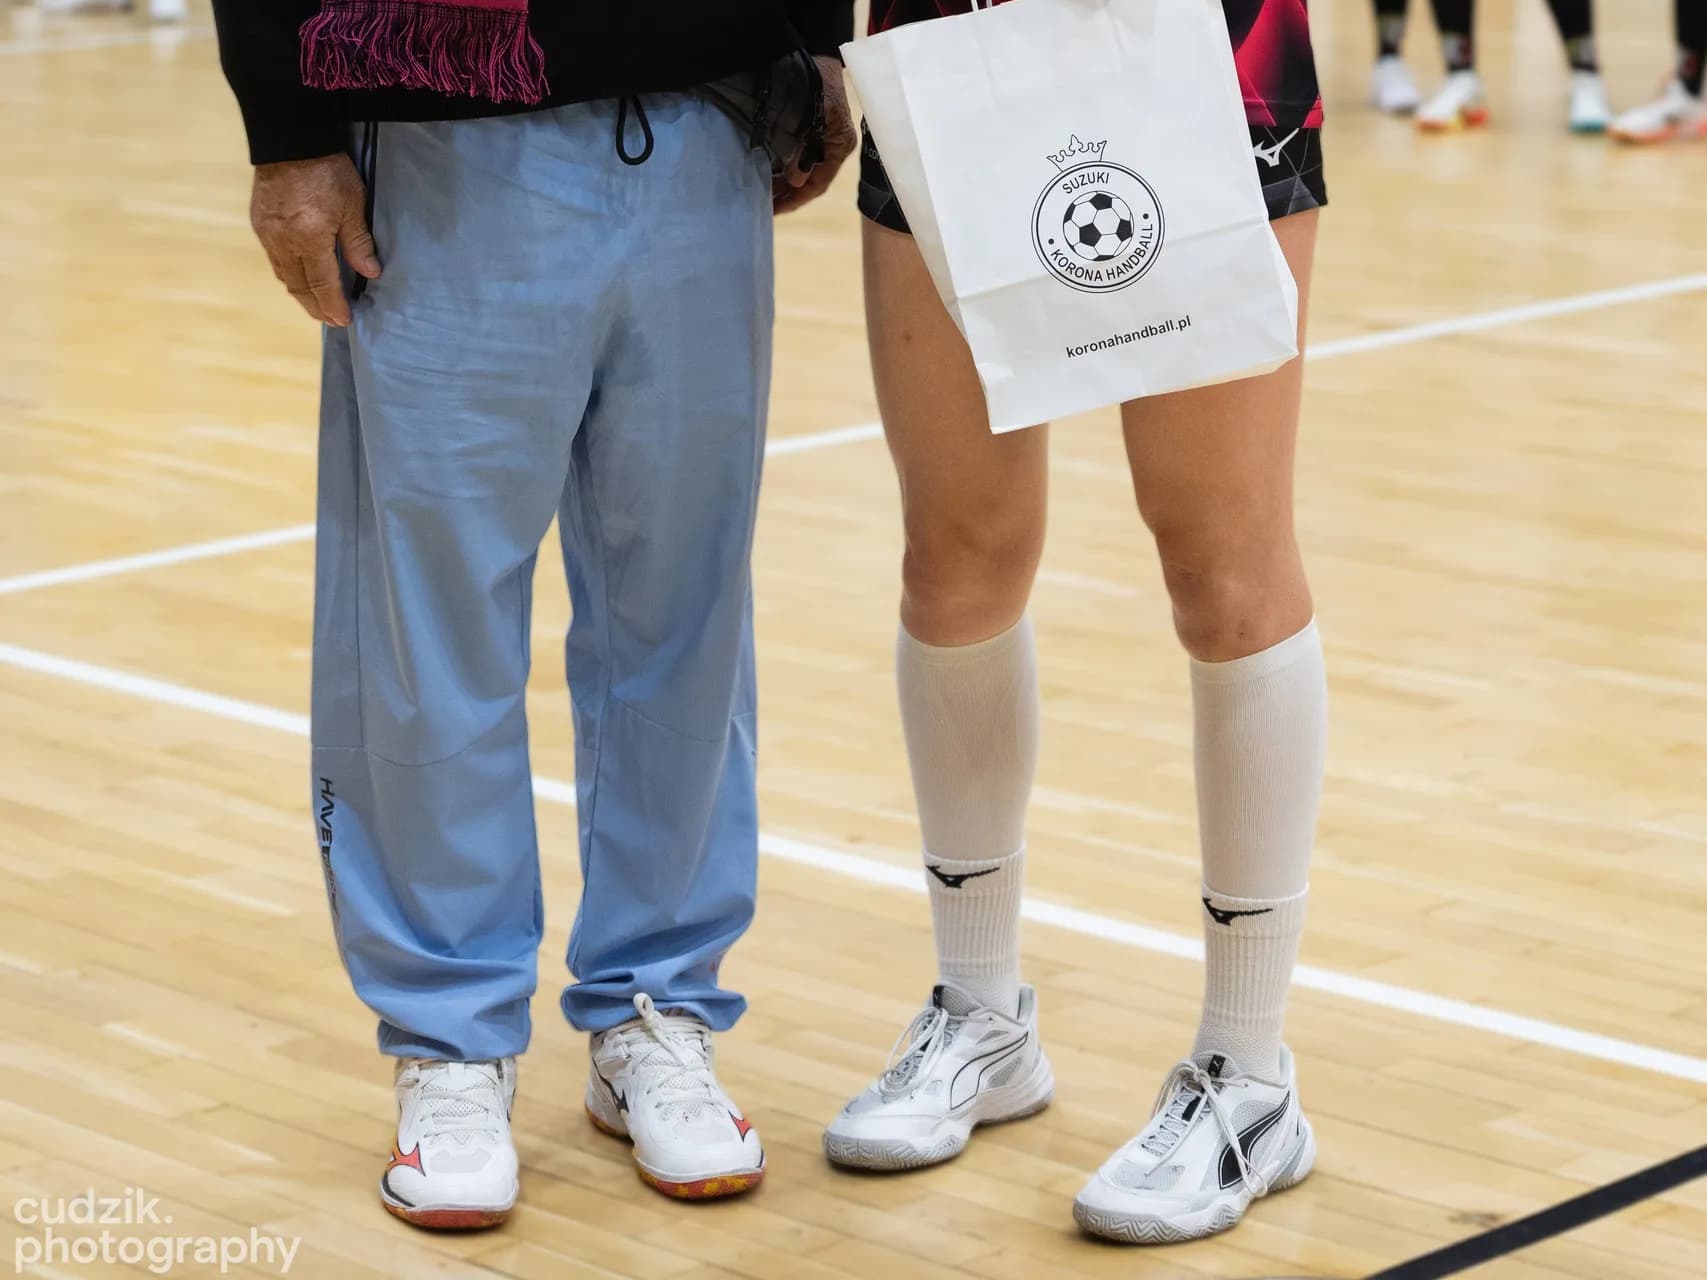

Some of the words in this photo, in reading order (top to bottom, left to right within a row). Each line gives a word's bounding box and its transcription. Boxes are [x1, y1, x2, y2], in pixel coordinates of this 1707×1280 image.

[1062, 172, 1110, 195] SUZUKI
[1050, 248, 1103, 282] KORONA
[1106, 223, 1153, 282] HANDBALL
[1066, 315, 1192, 358] koronahandball.pl
